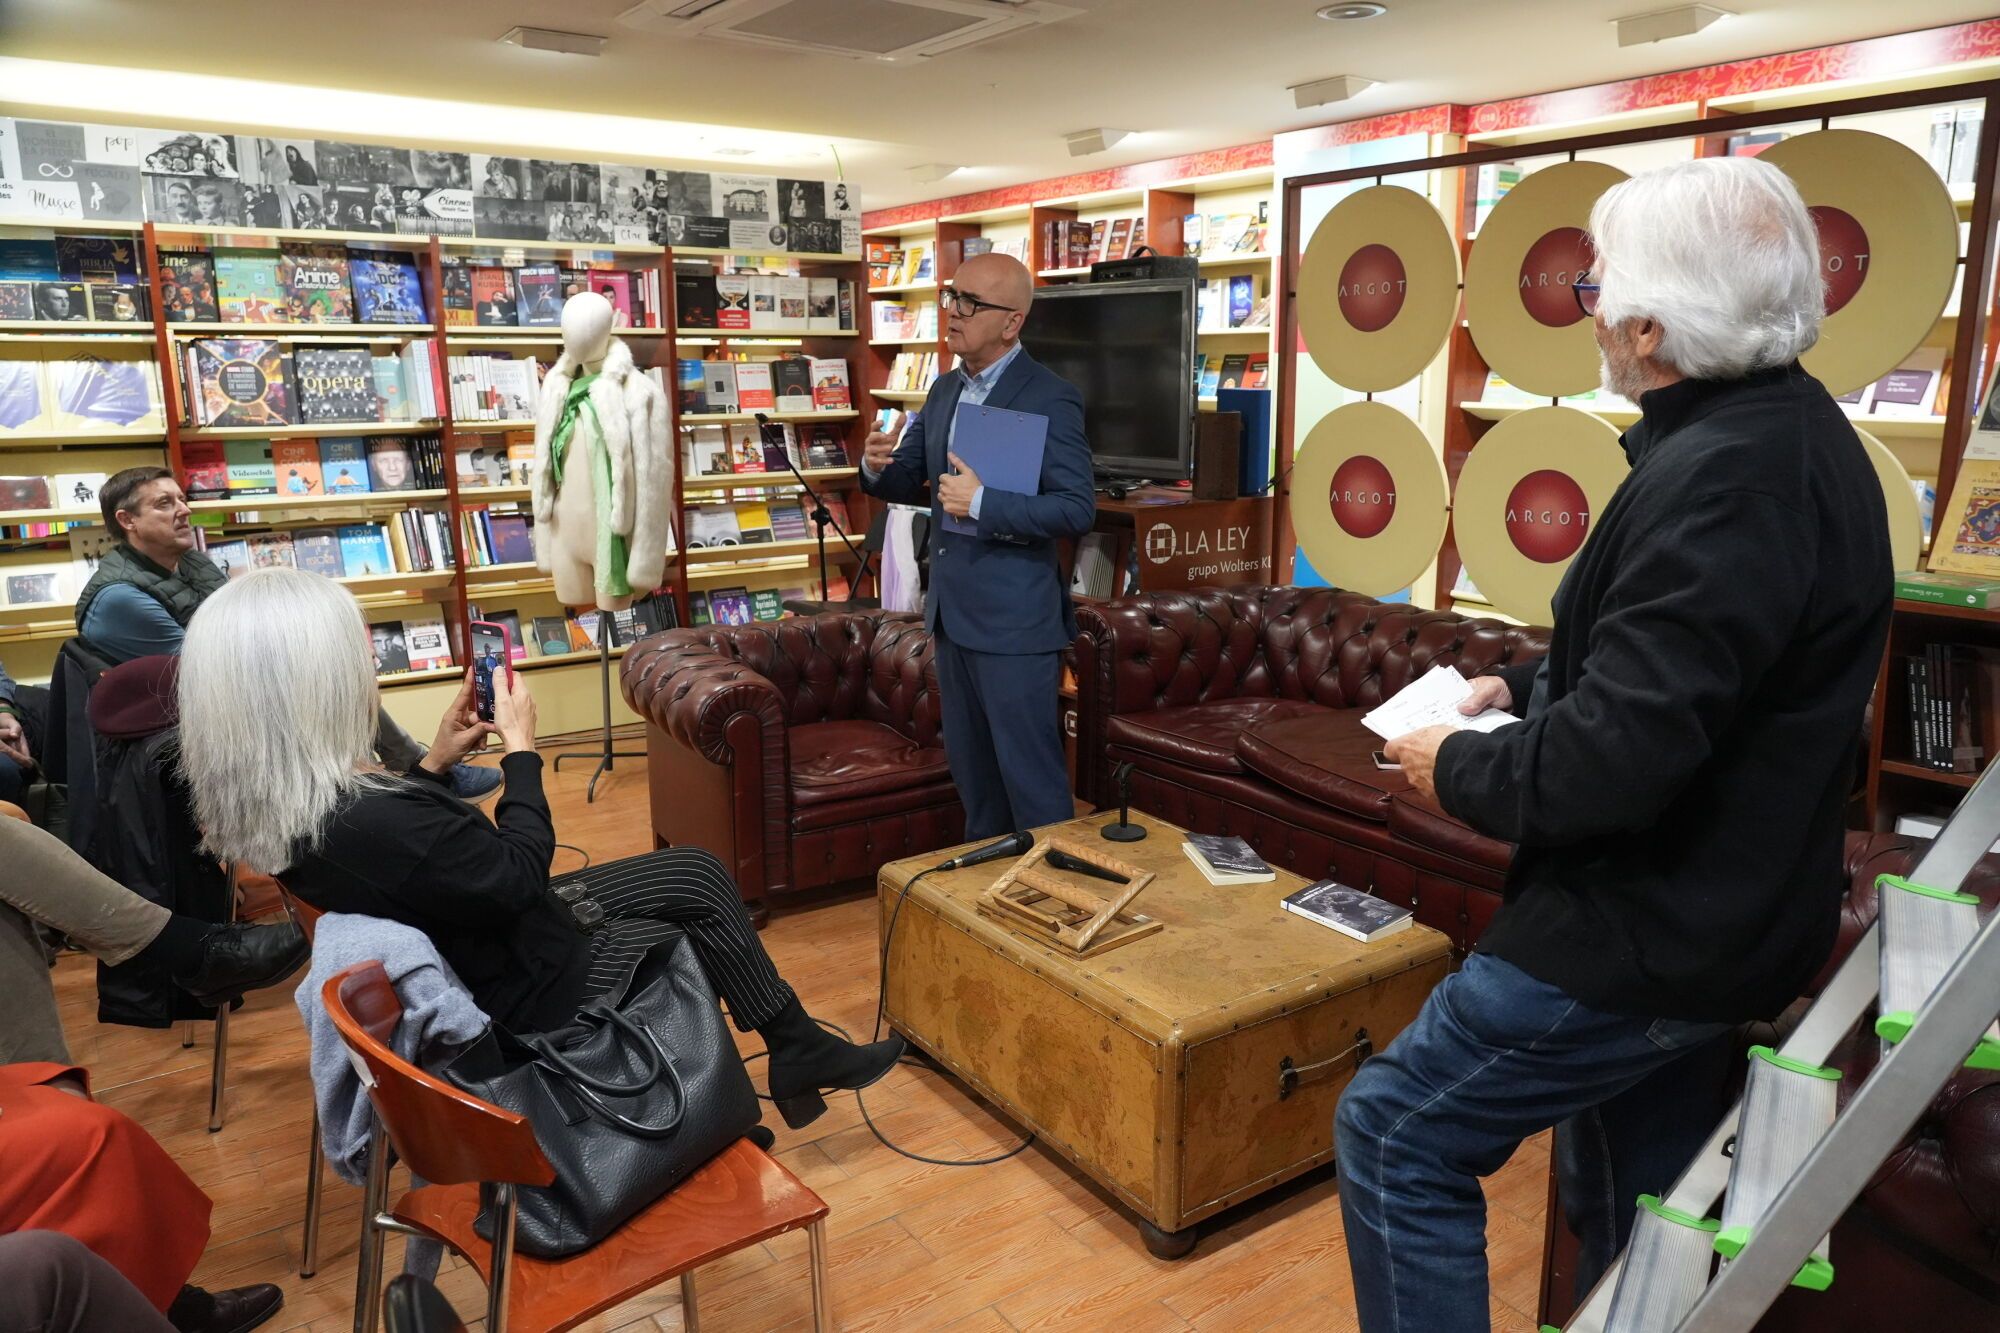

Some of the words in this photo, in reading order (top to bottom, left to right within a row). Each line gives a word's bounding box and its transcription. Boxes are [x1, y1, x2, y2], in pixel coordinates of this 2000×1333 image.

[438, 196, 472, 206] Cinema
[294, 267, 340, 284] Anime
[1339, 279, 1407, 298] ARGOT
[303, 369, 367, 397] ópera
[331, 443, 353, 452] CINE
[232, 468, 273, 477] Videoclub
[1330, 491, 1395, 505] ARGOT
[1506, 508, 1589, 526] ARGOT
[347, 529, 373, 537] TOM
[1185, 530, 1210, 555] LA
[1217, 526, 1250, 552] LEY
[341, 537, 383, 546] HANKS
[1187, 565, 1218, 581] grupo
[1220, 558, 1259, 574] Wolters
